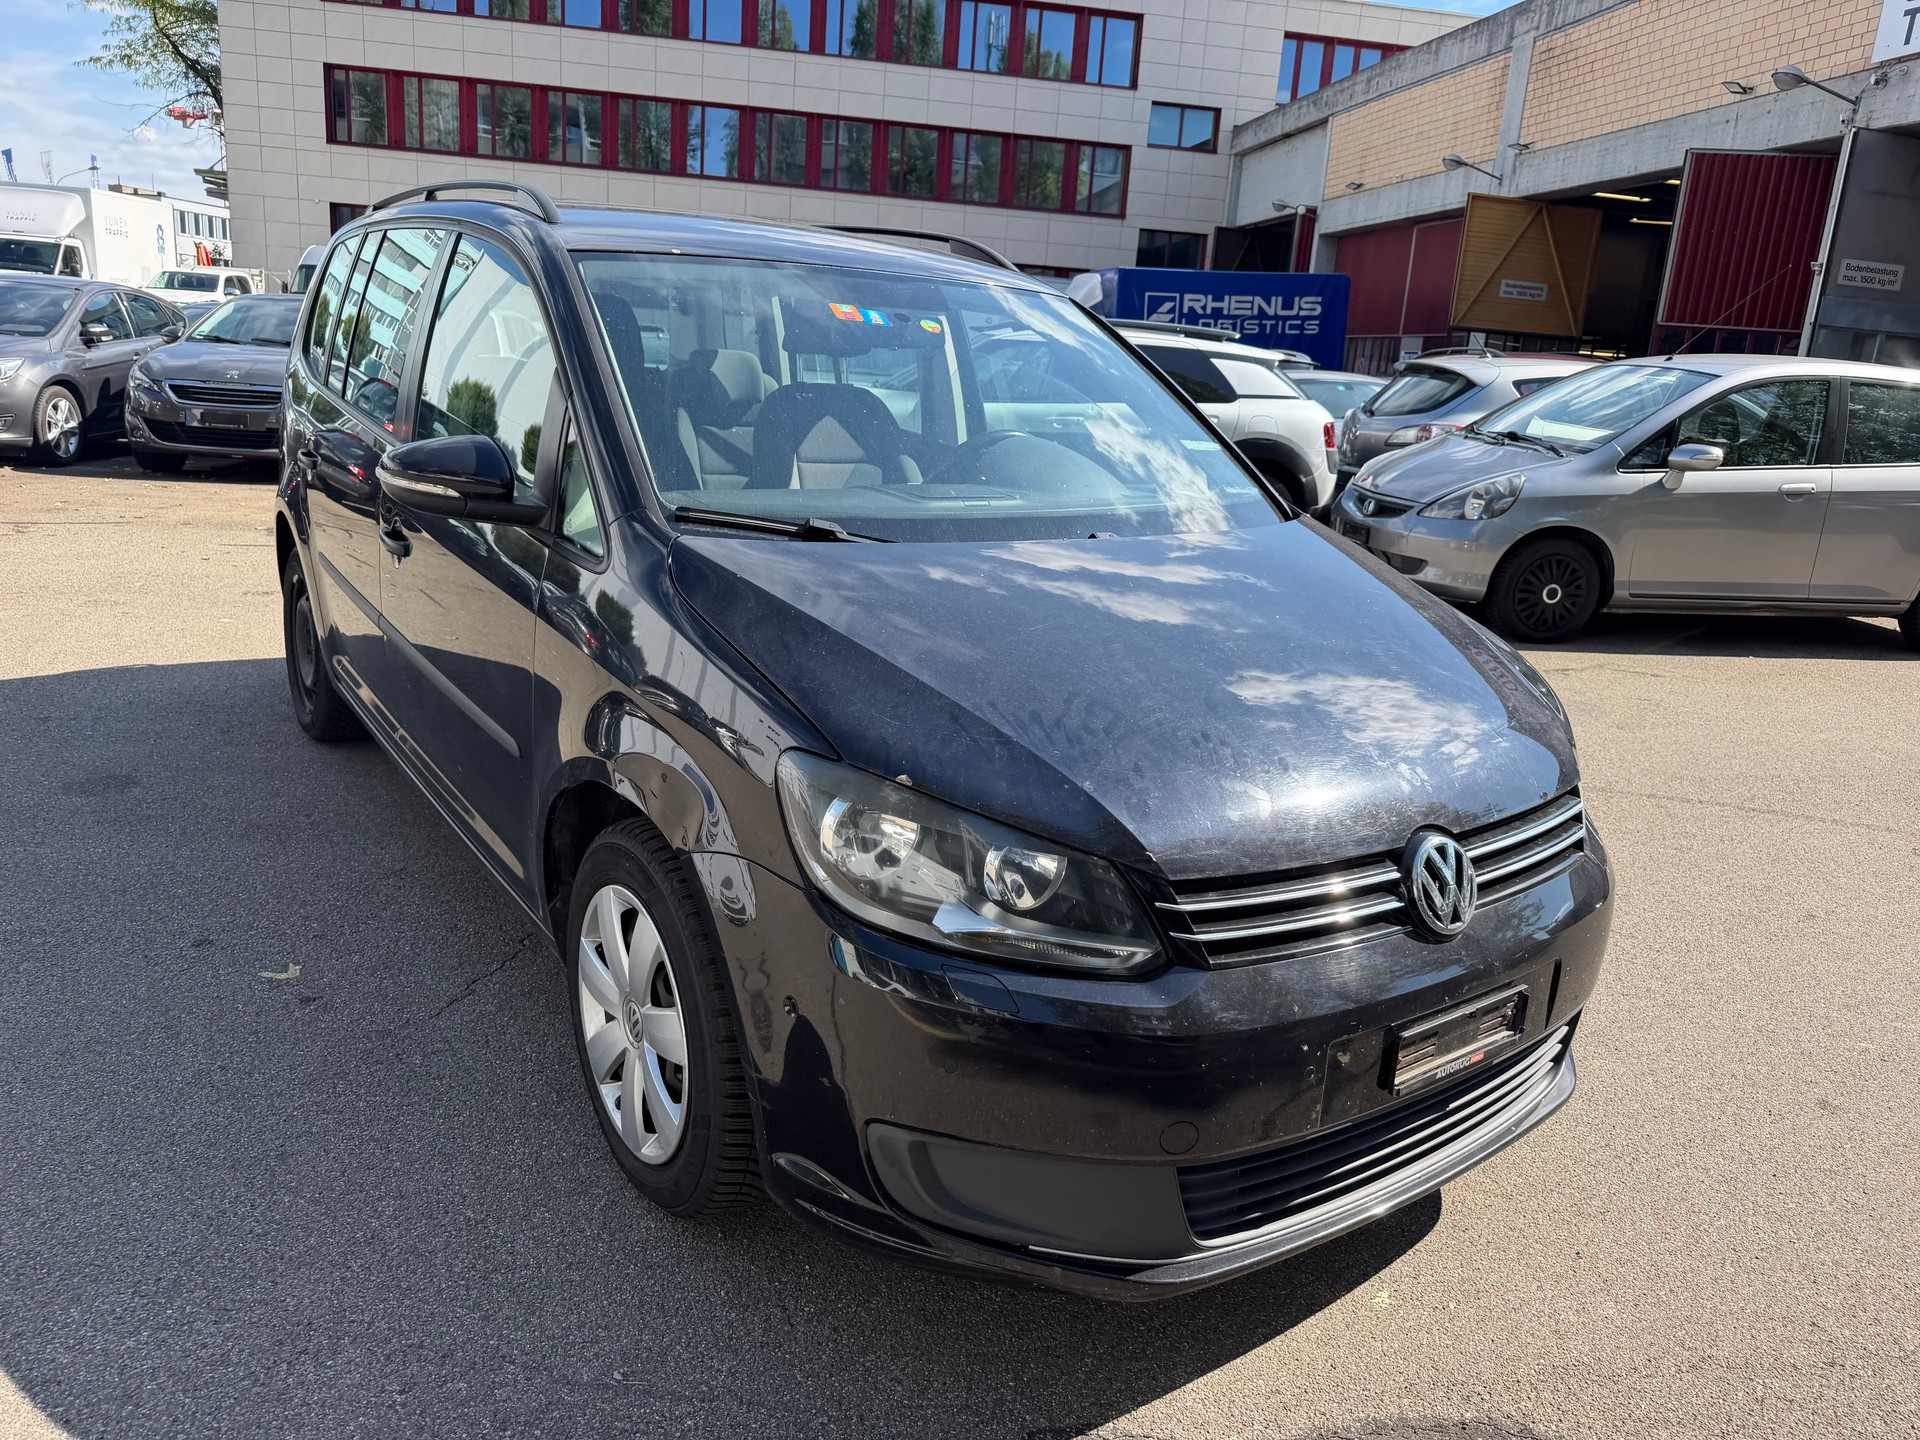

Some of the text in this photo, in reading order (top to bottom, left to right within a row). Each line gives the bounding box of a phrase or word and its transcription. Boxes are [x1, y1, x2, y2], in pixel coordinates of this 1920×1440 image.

[105, 228, 129, 238] TRAFFIC
[1845, 262, 1899, 278] Bodenbelastung
[1842, 274, 1858, 283] max.
[1860, 275, 1877, 285] 1500
[1182, 293, 1322, 316] RHENUS
